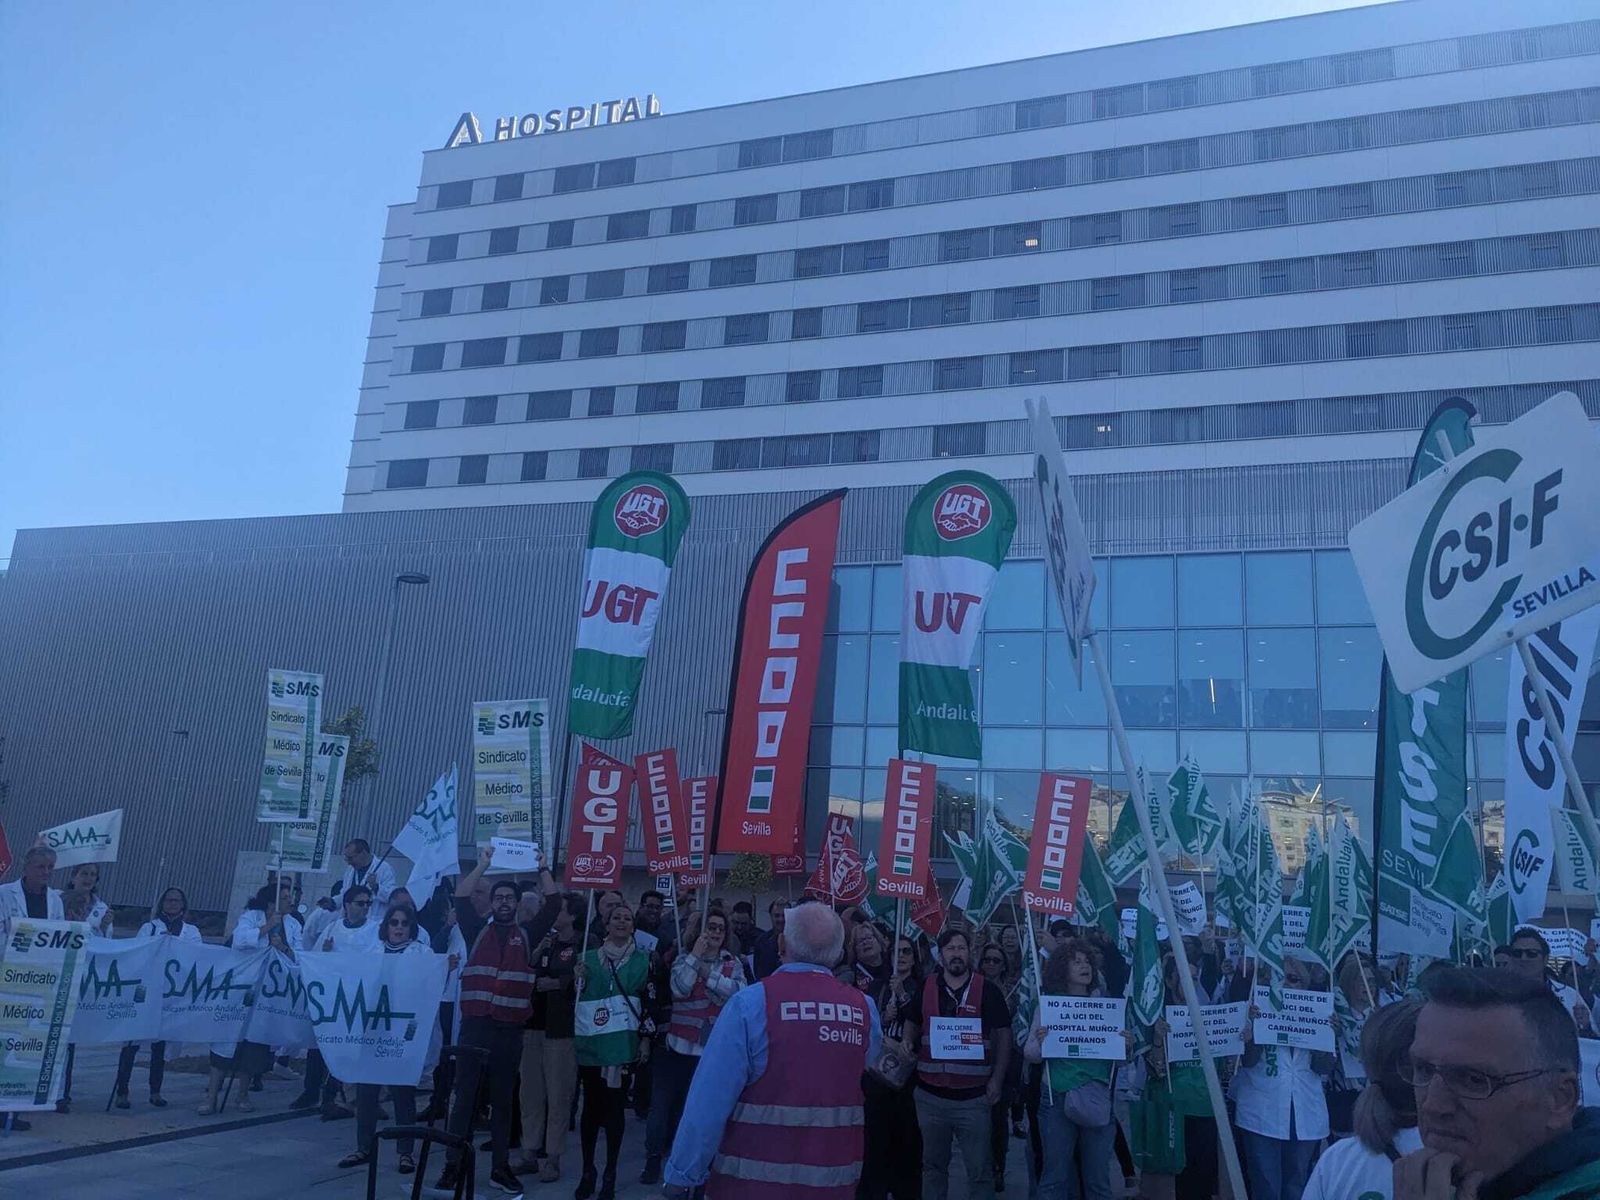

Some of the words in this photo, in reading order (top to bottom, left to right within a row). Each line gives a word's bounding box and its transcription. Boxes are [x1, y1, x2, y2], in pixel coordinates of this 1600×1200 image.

[495, 94, 662, 141] HOSPITAL
[624, 492, 663, 518] UGT
[943, 492, 986, 518] UGT
[1512, 566, 1596, 618] SEVILLA
[756, 547, 809, 758] CCOO
[572, 684, 631, 707] dalucía
[271, 711, 305, 724] Sindicato
[273, 739, 300, 751] Médico
[318, 742, 345, 757] MS
[479, 751, 526, 764] Sindicato
[265, 765, 275, 776] de
[277, 765, 302, 777] Sevilla
[1399, 687, 1440, 868] TSE
[485, 783, 523, 796] Médico
[479, 813, 492, 825] de
[495, 812, 528, 824] Sevilla
[583, 770, 622, 852] UGT
[741, 821, 772, 837] Sevilla
[48, 827, 109, 848] SMA
[650, 856, 690, 872] Sevilla
[1382, 849, 1425, 889] SEVIL
[878, 878, 924, 896] Sevilla
[1023, 891, 1073, 912] Sevilla
[4, 969, 57, 984] Sindicato
[1074, 1001, 1104, 1009] CIERRE
[1284, 993, 1315, 1001] CIERRE
[3, 1005, 45, 1019] Médico
[307, 977, 416, 1034] SMA
[780, 1001, 853, 1023] CCOO
[1047, 1024, 1086, 1032] HOSPITAL
[1299, 1016, 1329, 1025] MUÑOZ
[818, 1026, 863, 1046] Sevilla
[1268, 1024, 1316, 1035] CARIÑANOS
[6, 1038, 43, 1051] Sevilla
[319, 1034, 343, 1044] dicato
[345, 1034, 374, 1046] Médico
